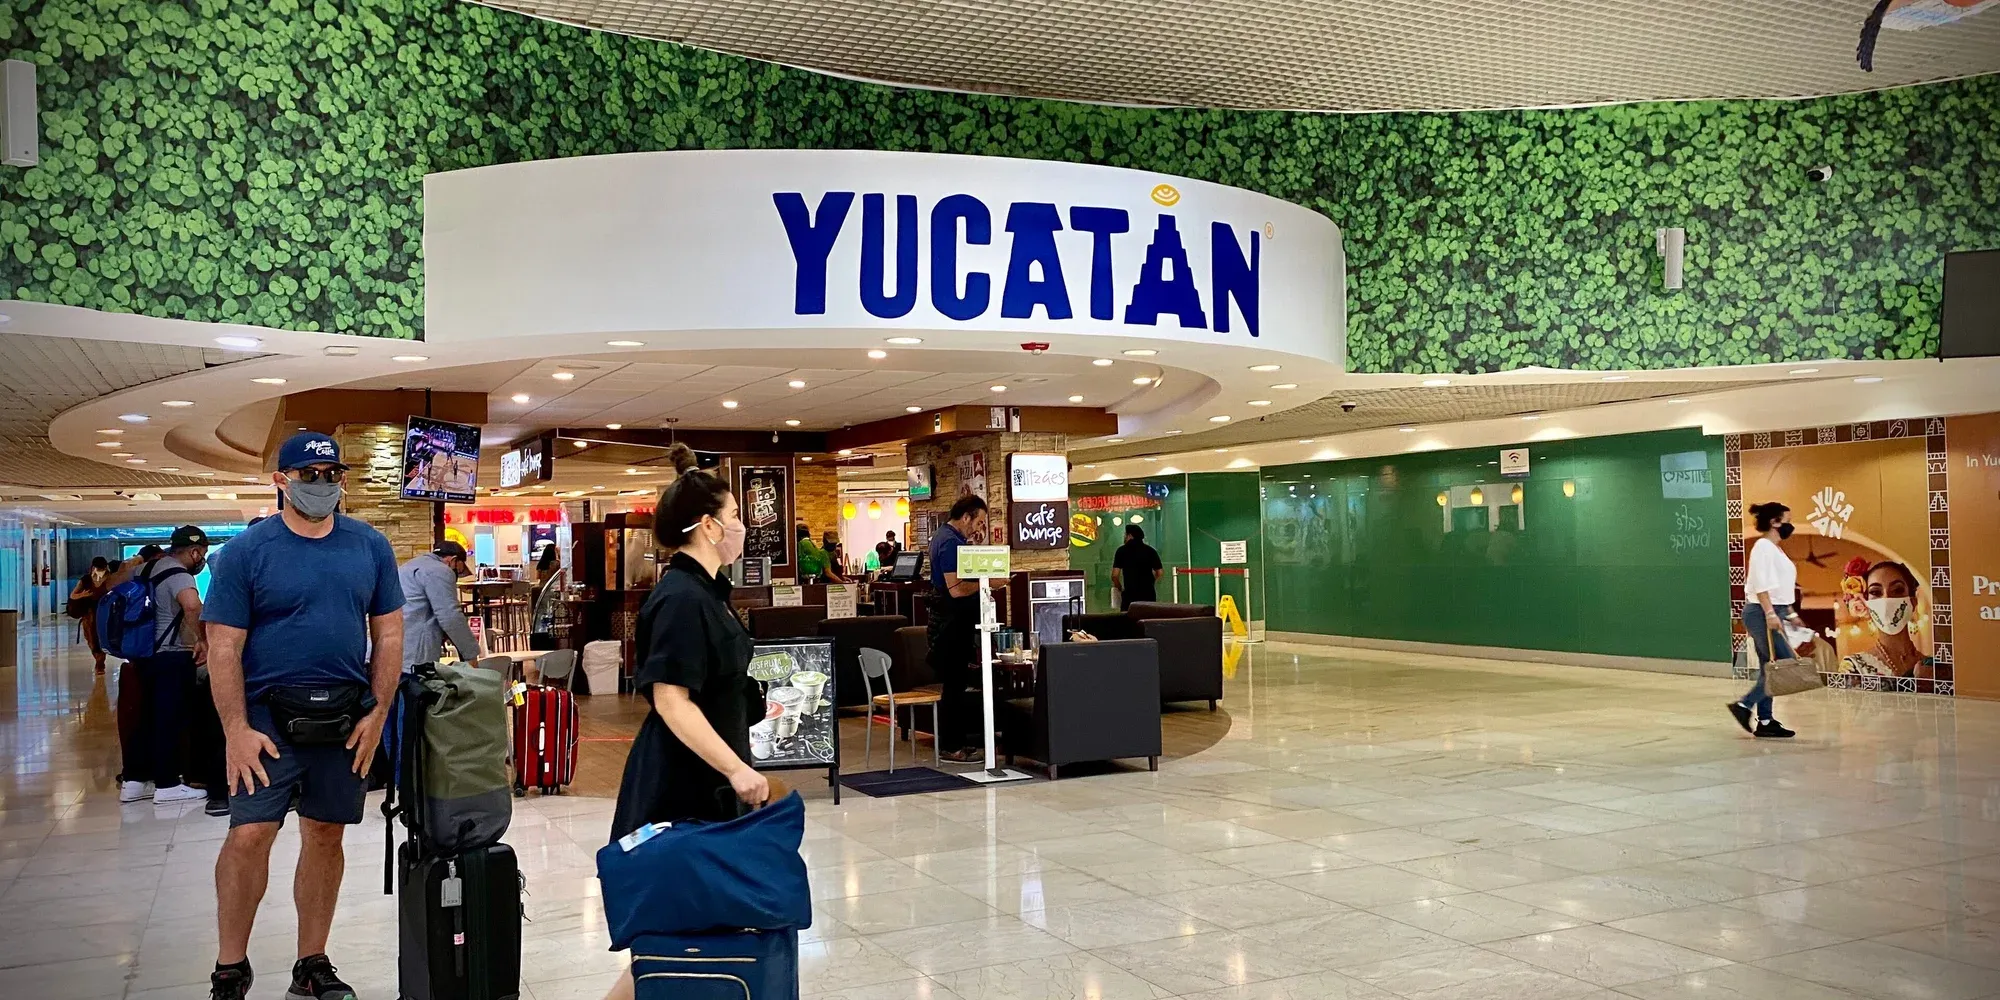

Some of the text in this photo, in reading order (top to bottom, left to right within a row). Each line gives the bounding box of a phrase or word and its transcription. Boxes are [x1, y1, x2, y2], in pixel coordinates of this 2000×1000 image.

[1966, 455, 1979, 468] In
[1025, 503, 1056, 526] café
[1019, 522, 1063, 546] lounge
[1972, 575, 2000, 595] Pr
